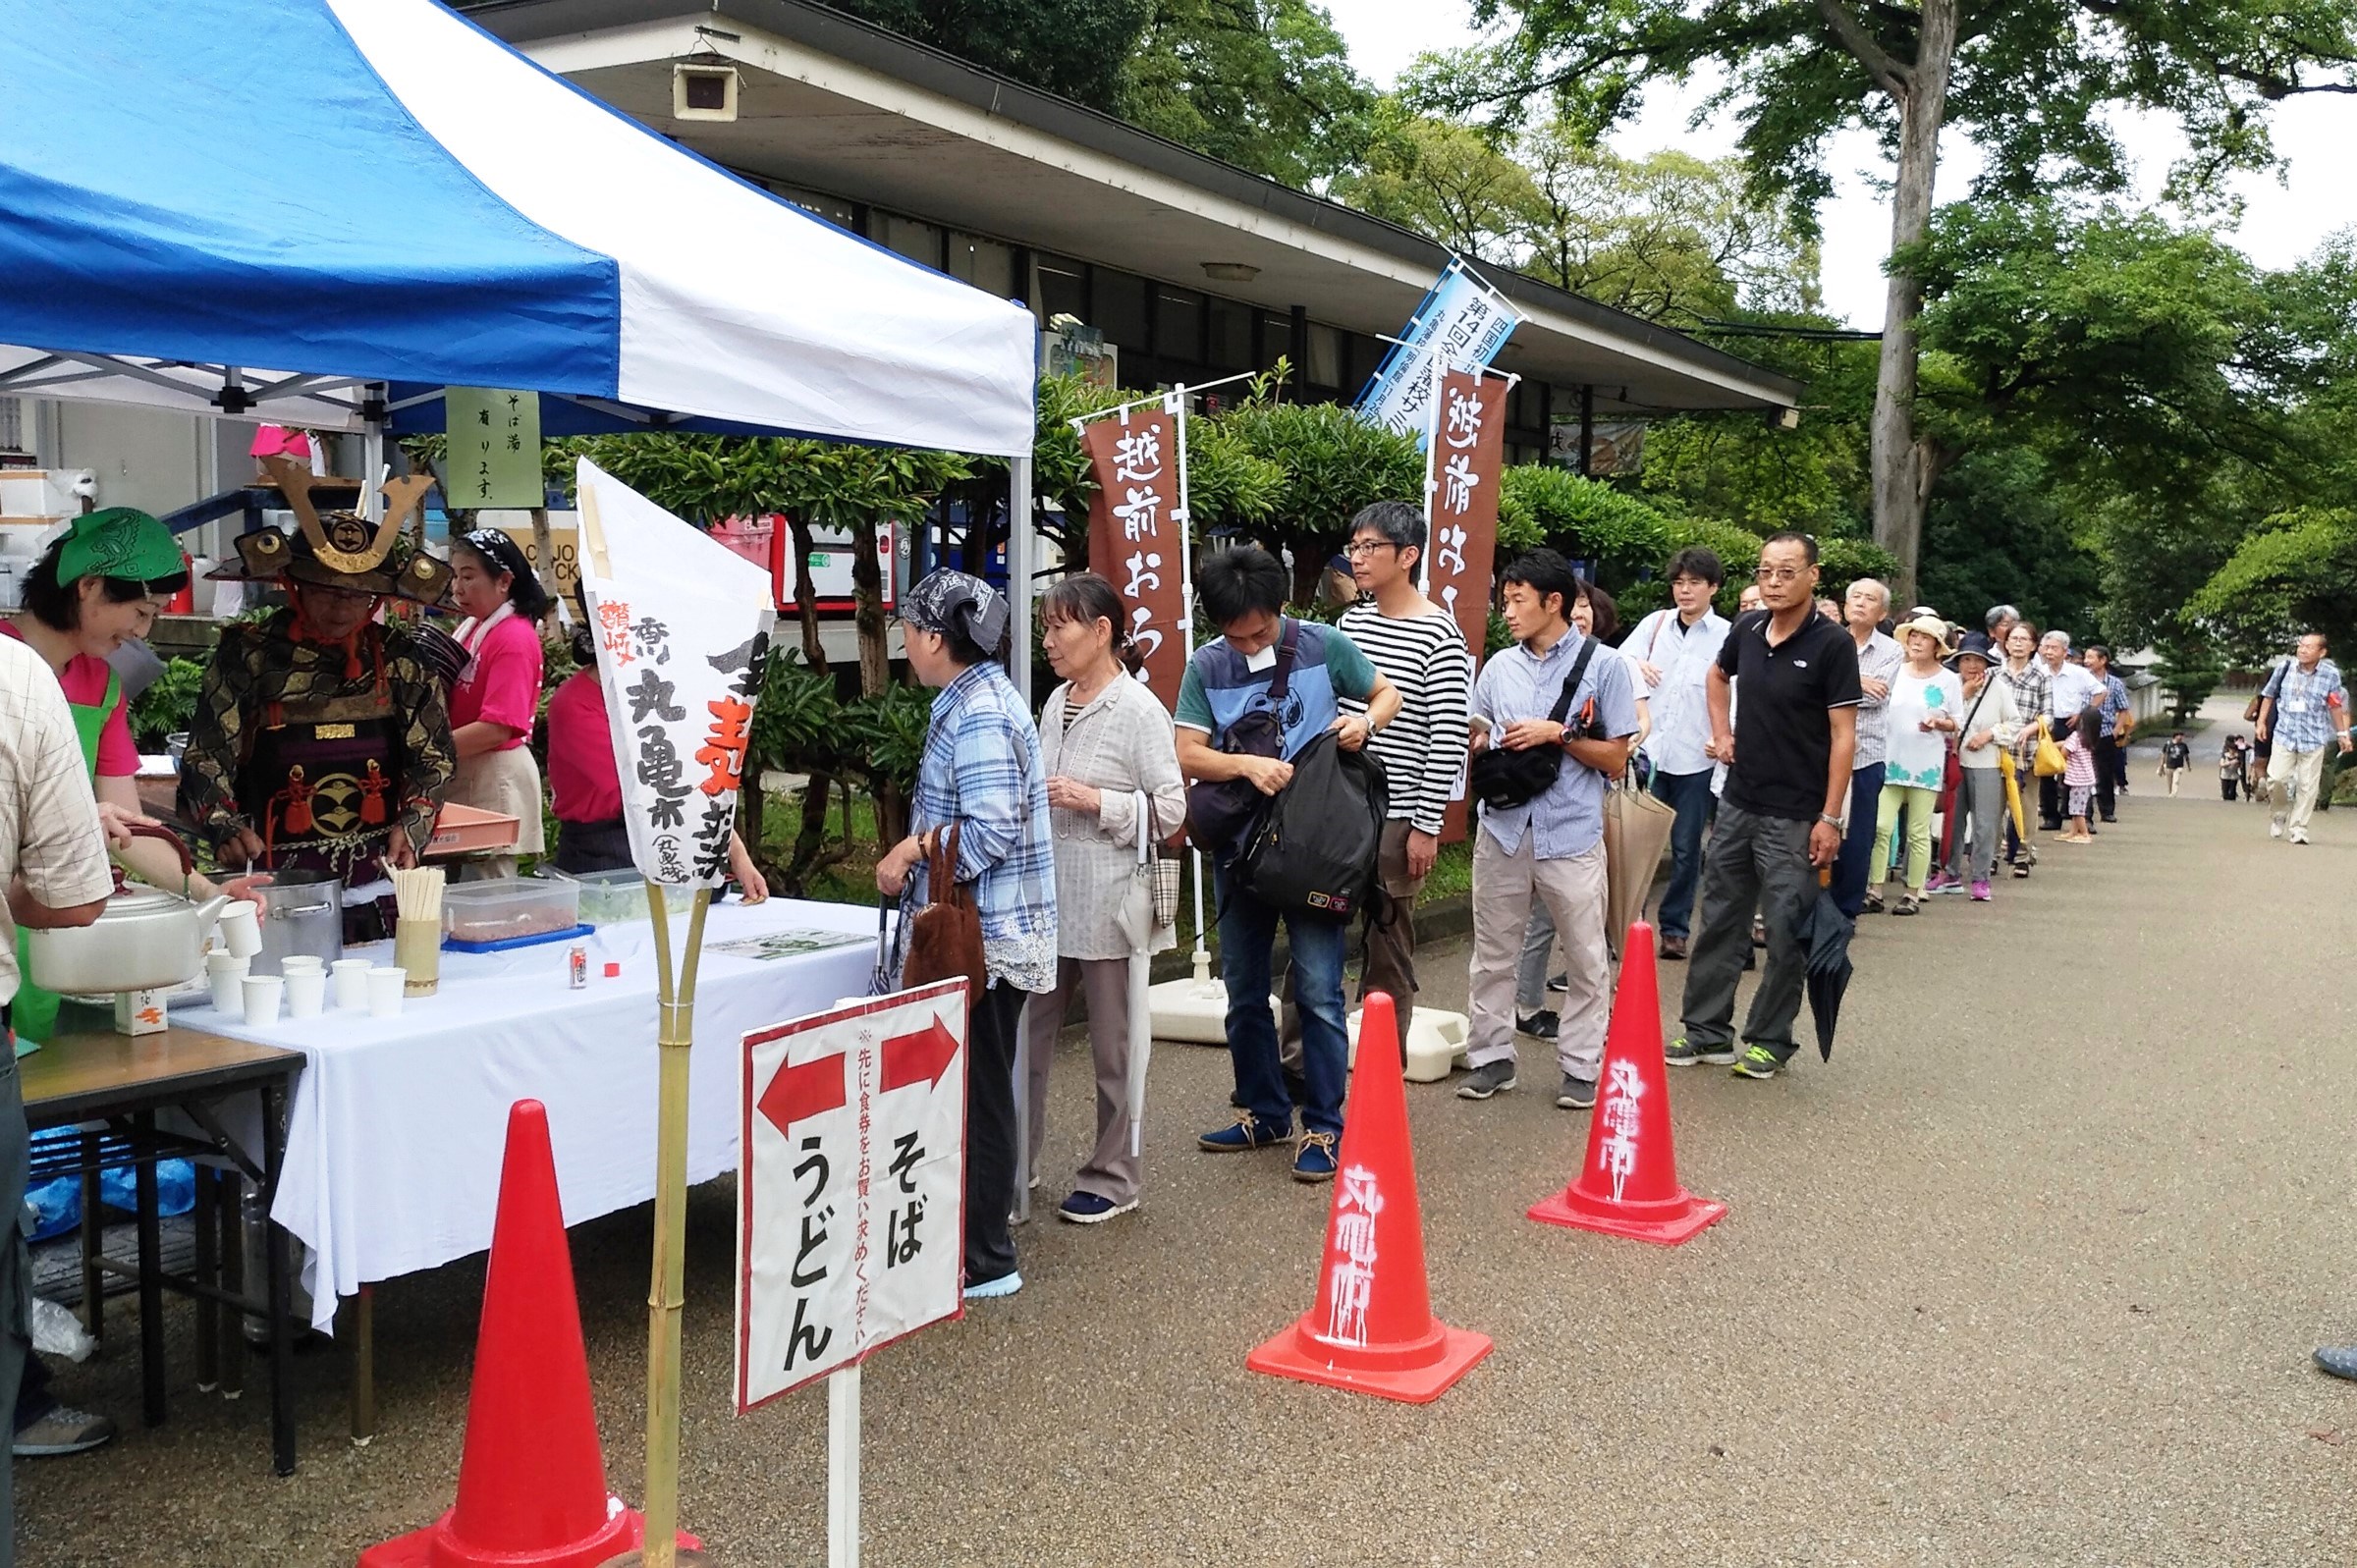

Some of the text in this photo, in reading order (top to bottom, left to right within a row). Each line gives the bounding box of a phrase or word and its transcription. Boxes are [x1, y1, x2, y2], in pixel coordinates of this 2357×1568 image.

[783, 1136, 835, 1372] うどん
[887, 1130, 928, 1270] そば
